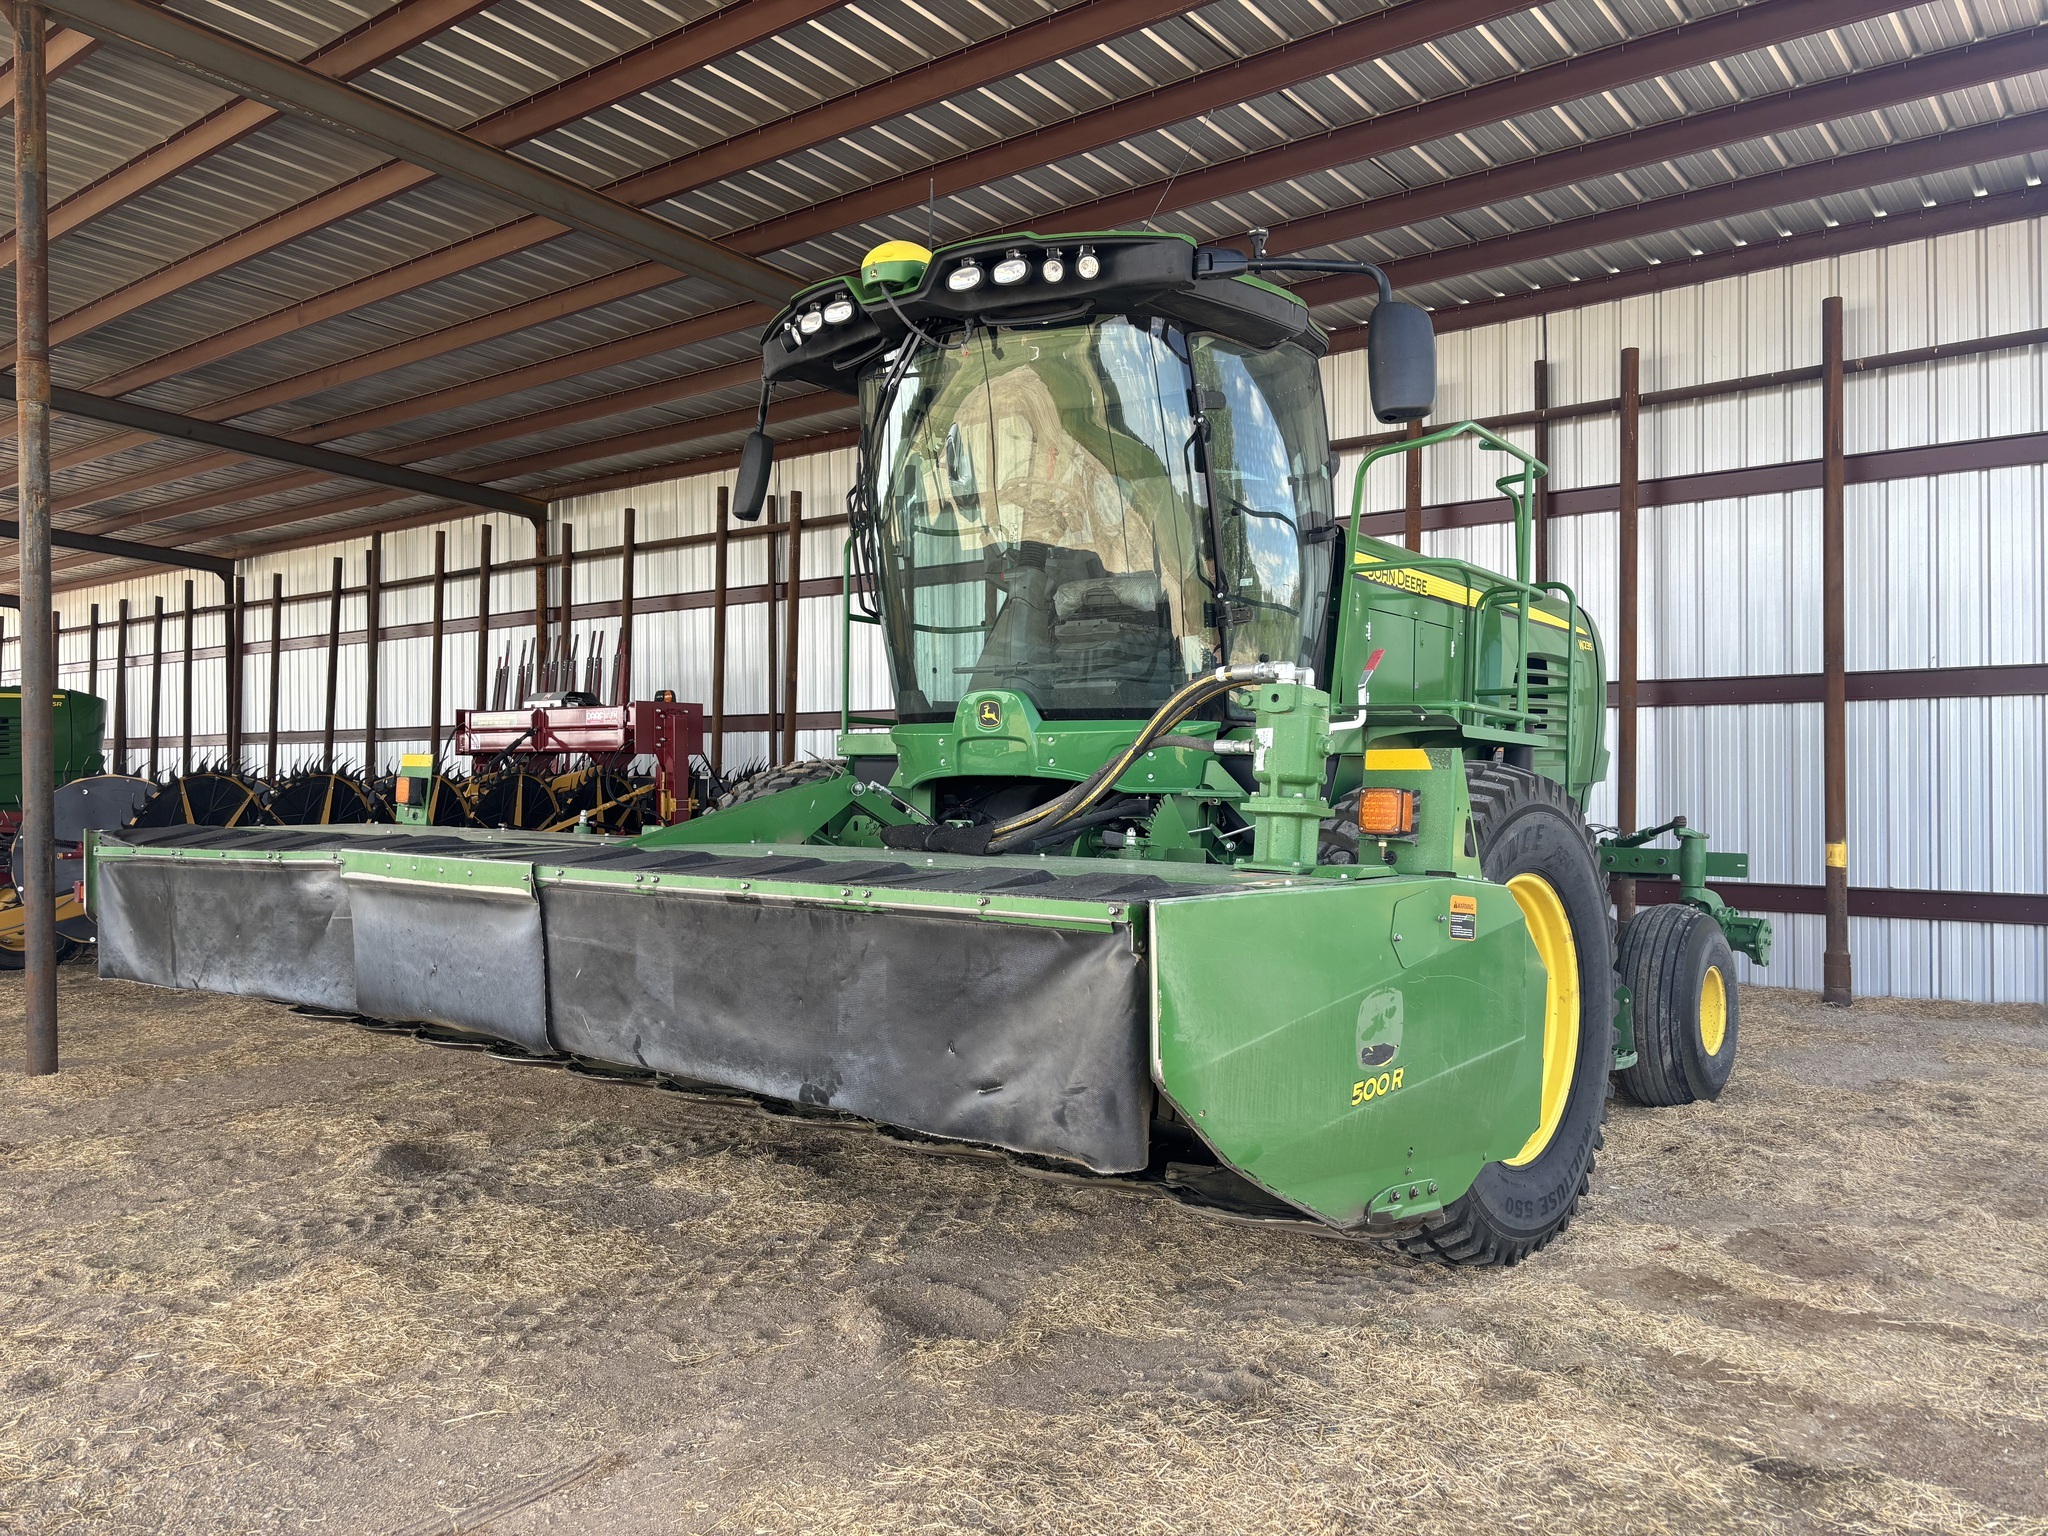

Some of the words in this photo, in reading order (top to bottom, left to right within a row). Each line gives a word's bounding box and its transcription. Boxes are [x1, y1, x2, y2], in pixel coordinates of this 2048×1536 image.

[1397, 569, 1428, 594] DEERE
[1540, 1121, 1592, 1217] MULTIUSE
[1505, 1196, 1533, 1219] 550
